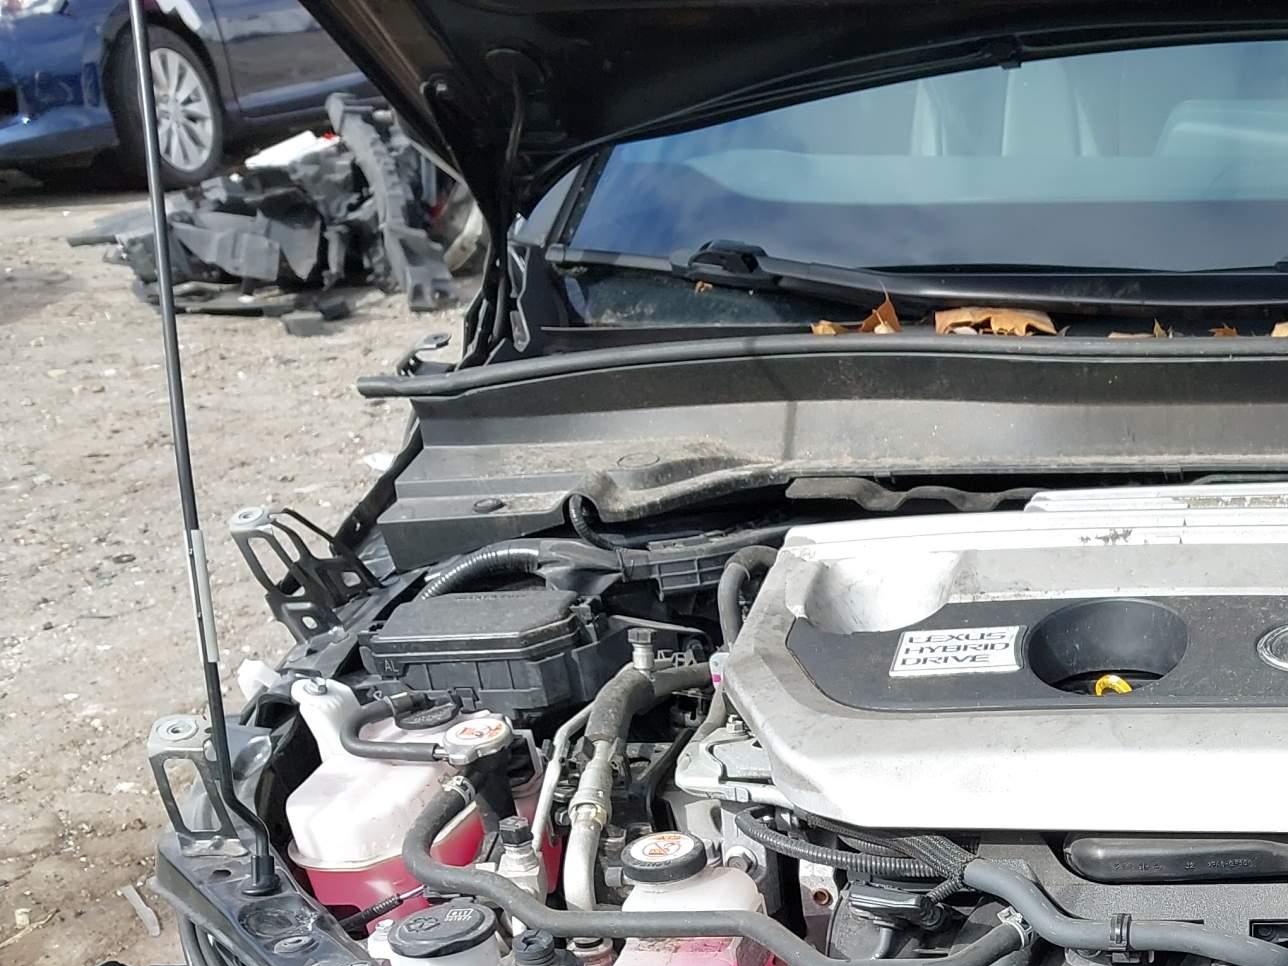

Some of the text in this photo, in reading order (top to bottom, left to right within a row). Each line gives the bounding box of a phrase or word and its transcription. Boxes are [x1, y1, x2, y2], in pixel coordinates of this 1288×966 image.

[908, 631, 1007, 644] LEXUS
[904, 642, 1010, 655] HYBRID
[901, 654, 991, 666] DRIVE
